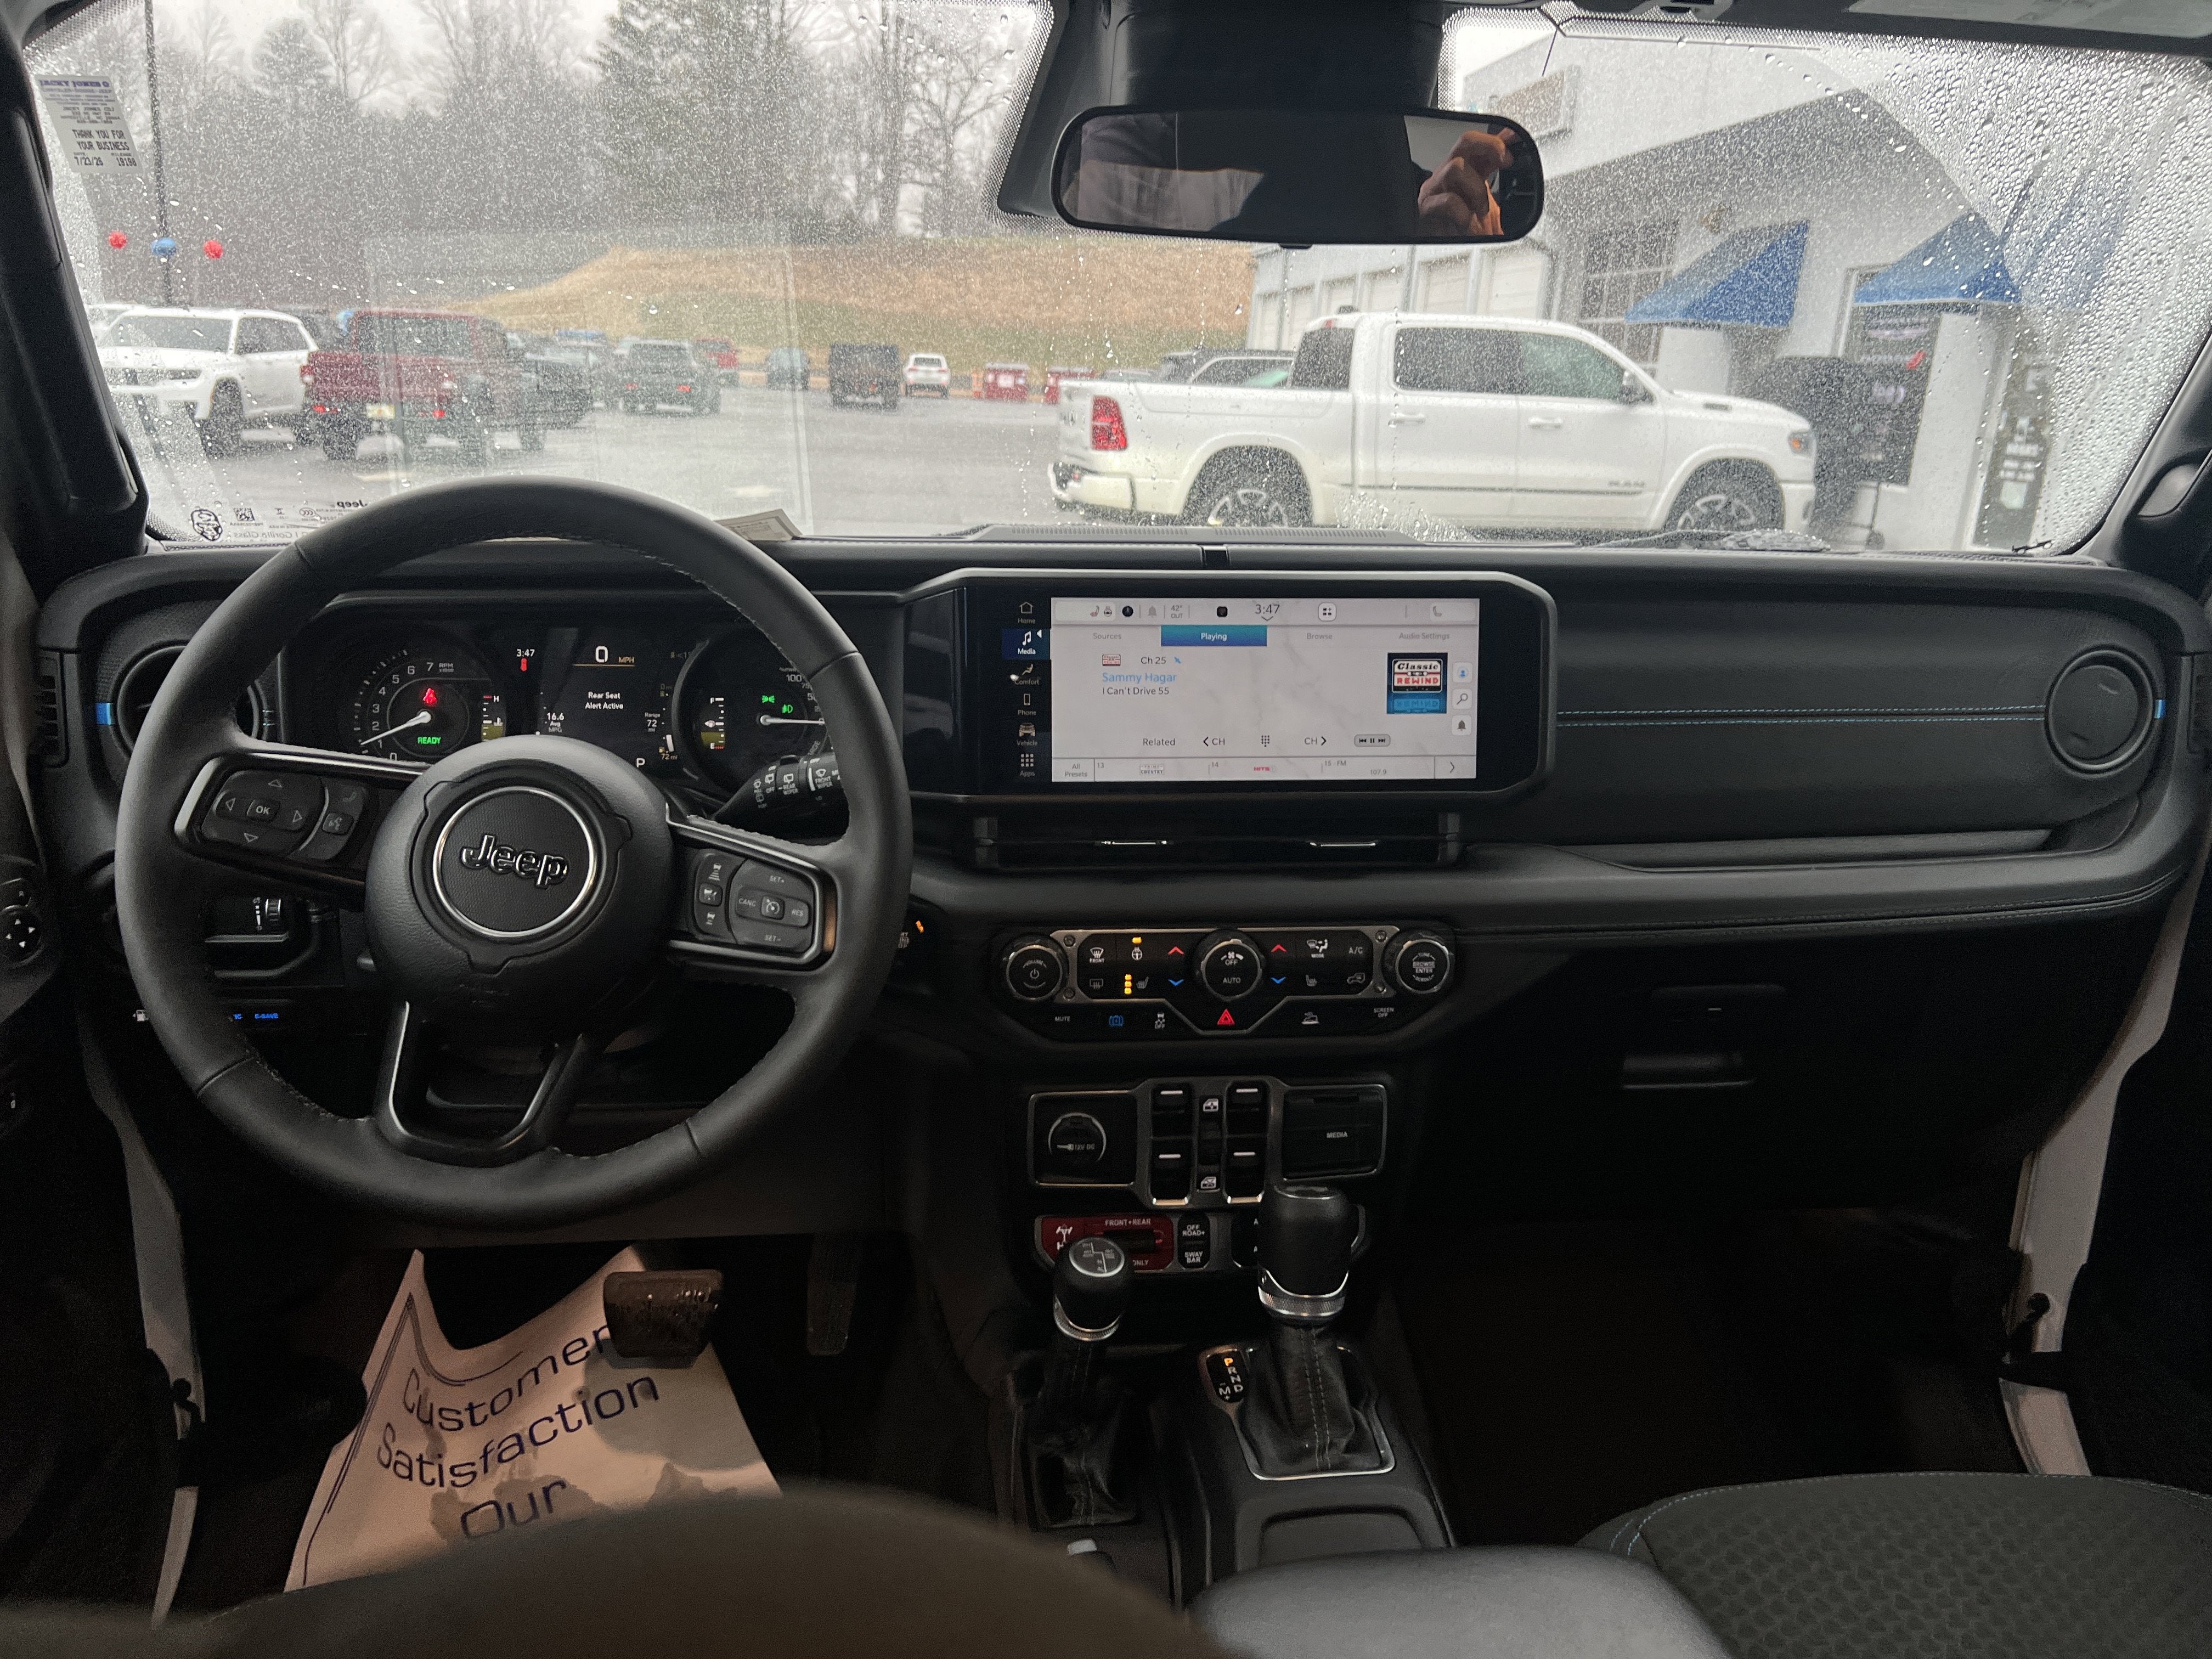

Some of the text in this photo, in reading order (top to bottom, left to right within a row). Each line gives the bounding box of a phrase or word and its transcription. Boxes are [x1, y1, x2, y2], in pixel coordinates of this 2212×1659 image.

[72, 129, 126, 139] THANK YOU FOR
[77, 141, 130, 151] YOUR BUSINESS
[1255, 604, 1280, 614] 3:47
[1200, 633, 1228, 641] Playing
[1421, 632, 1451, 641] Settings
[516, 649, 535, 657] 3:47
[595, 645, 608, 663] 0
[407, 665, 415, 675] 6
[427, 662, 434, 672] 7
[392, 675, 400, 684] 5
[786, 674, 803, 682] 100
[1102, 673, 1177, 684] Sammy Hagar
[378, 686, 386, 696] 4
[1133, 686, 1156, 695] Drive
[372, 703, 380, 713] 3
[547, 712, 565, 720] 16.6
[372, 721, 380, 730] 2
[647, 719, 657, 727] 72
[417, 736, 442, 744] READY
[1143, 737, 1176, 746] Related
[1304, 737, 1317, 746] CH
[636, 758, 645, 768] P
[256, 805, 270, 815] OK
[461, 834, 569, 889] Jeep
[1348, 946, 1363, 955] A/C
[1223, 1357, 1234, 1367] P
[1228, 1366, 1238, 1374] R
[403, 1323, 611, 1432] Customer
[1231, 1375, 1242, 1384] N
[1218, 1386, 1231, 1396] M
[1234, 1384, 1244, 1393] D
[376, 1375, 660, 1488] Satisfaction
[460, 1477, 568, 1538] Our
